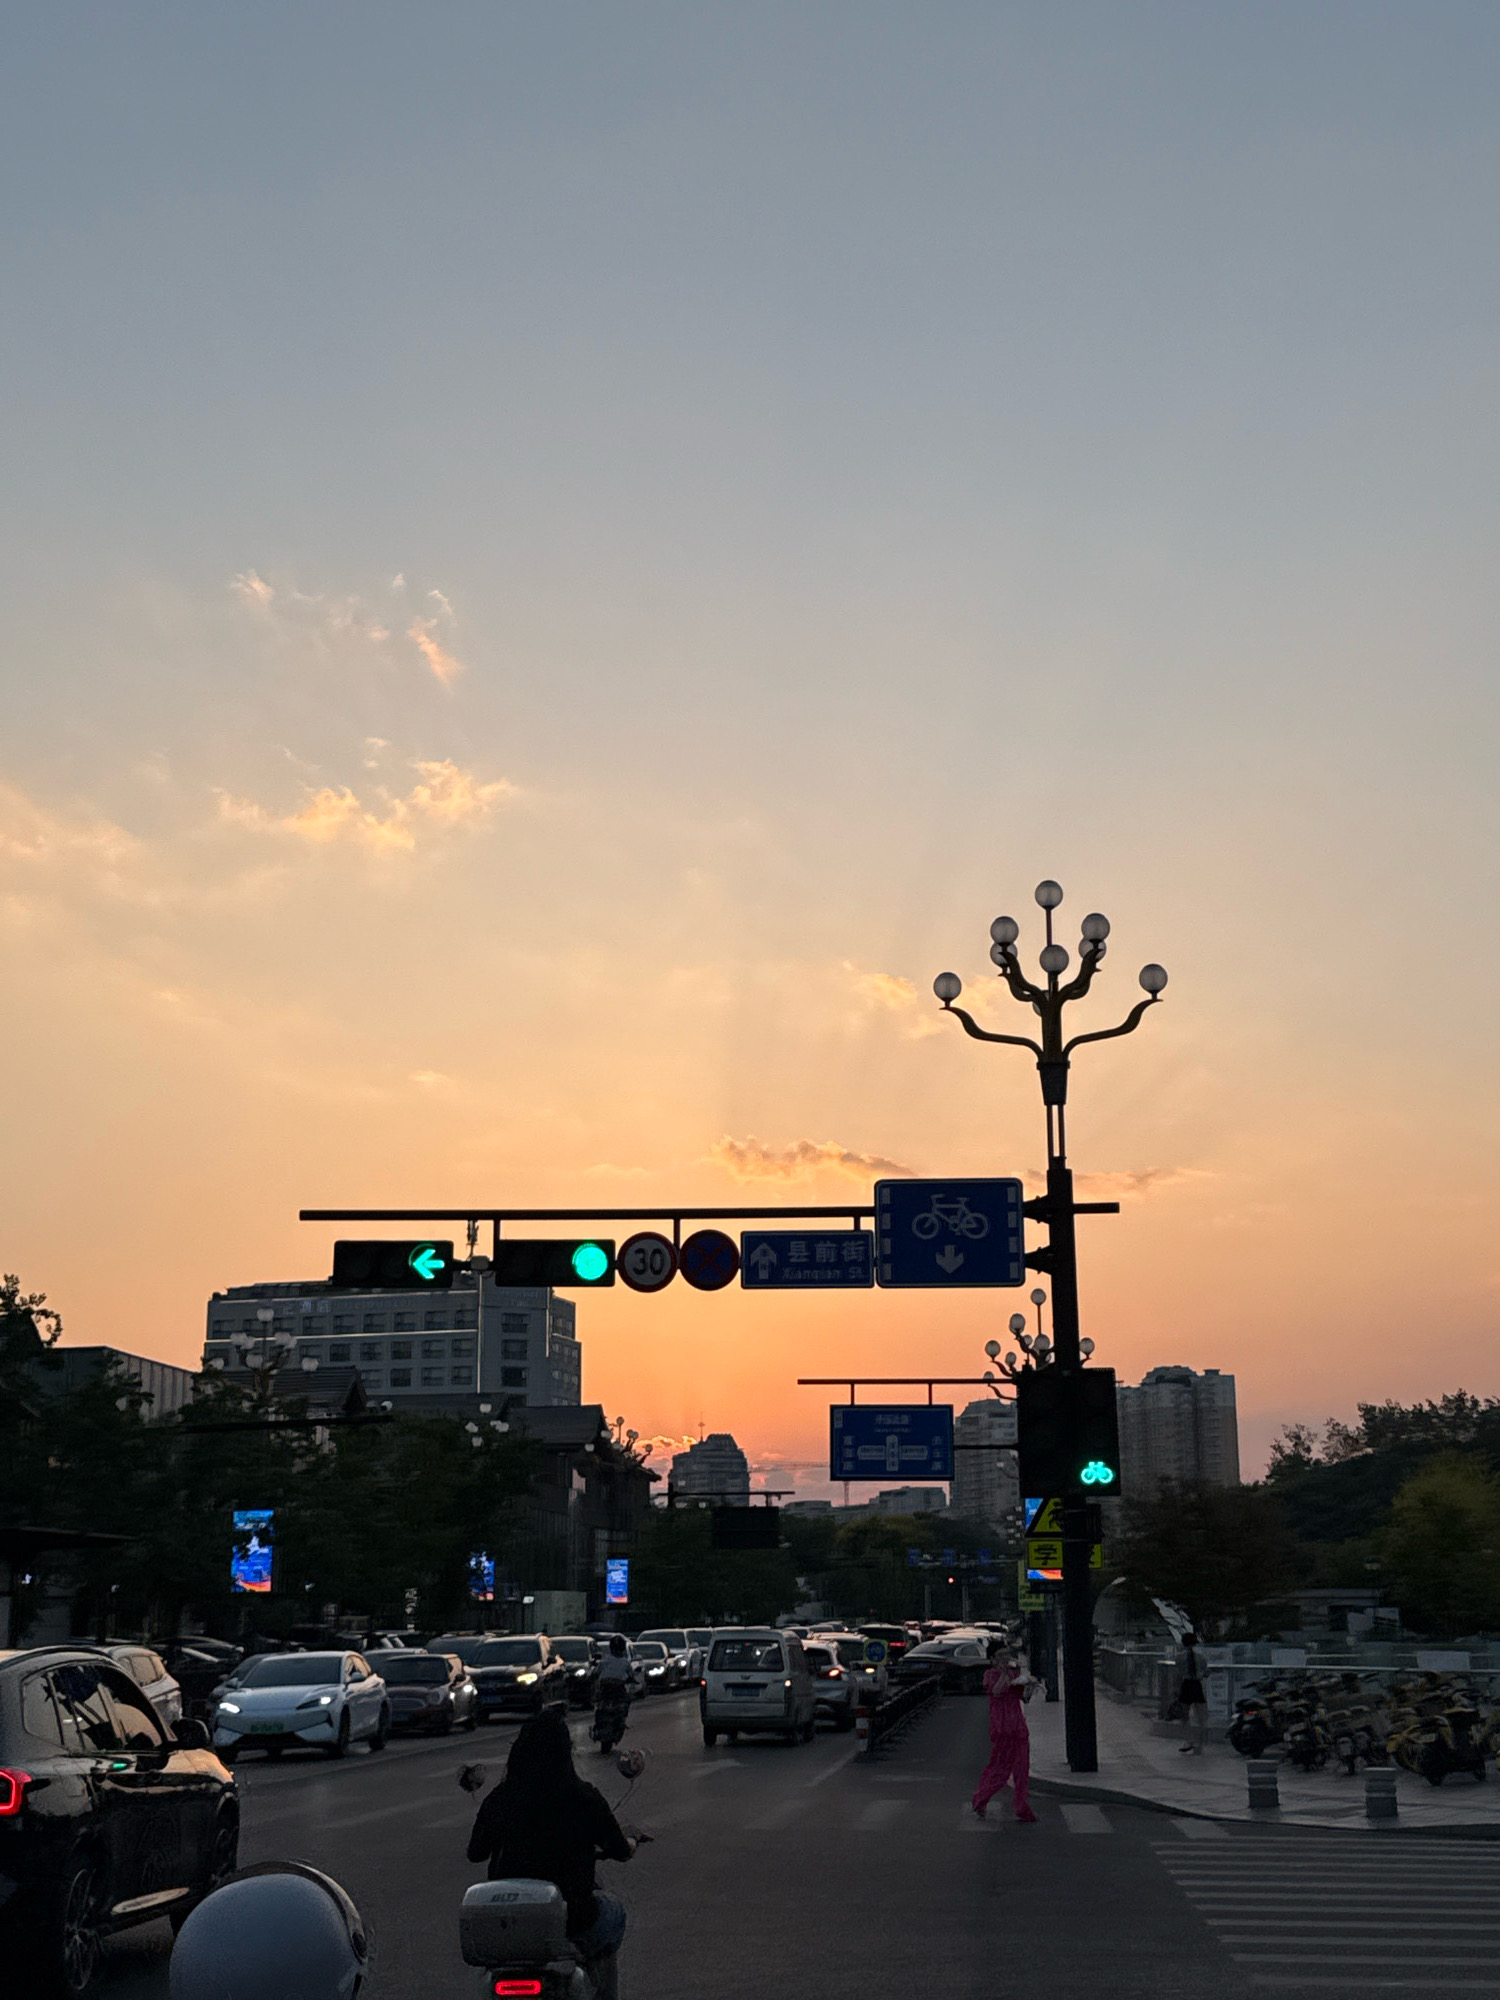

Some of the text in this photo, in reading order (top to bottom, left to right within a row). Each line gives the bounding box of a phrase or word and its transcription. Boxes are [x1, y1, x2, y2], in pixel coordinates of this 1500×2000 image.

[632, 1247, 664, 1275] 30
[787, 1239, 867, 1263] 县前街
